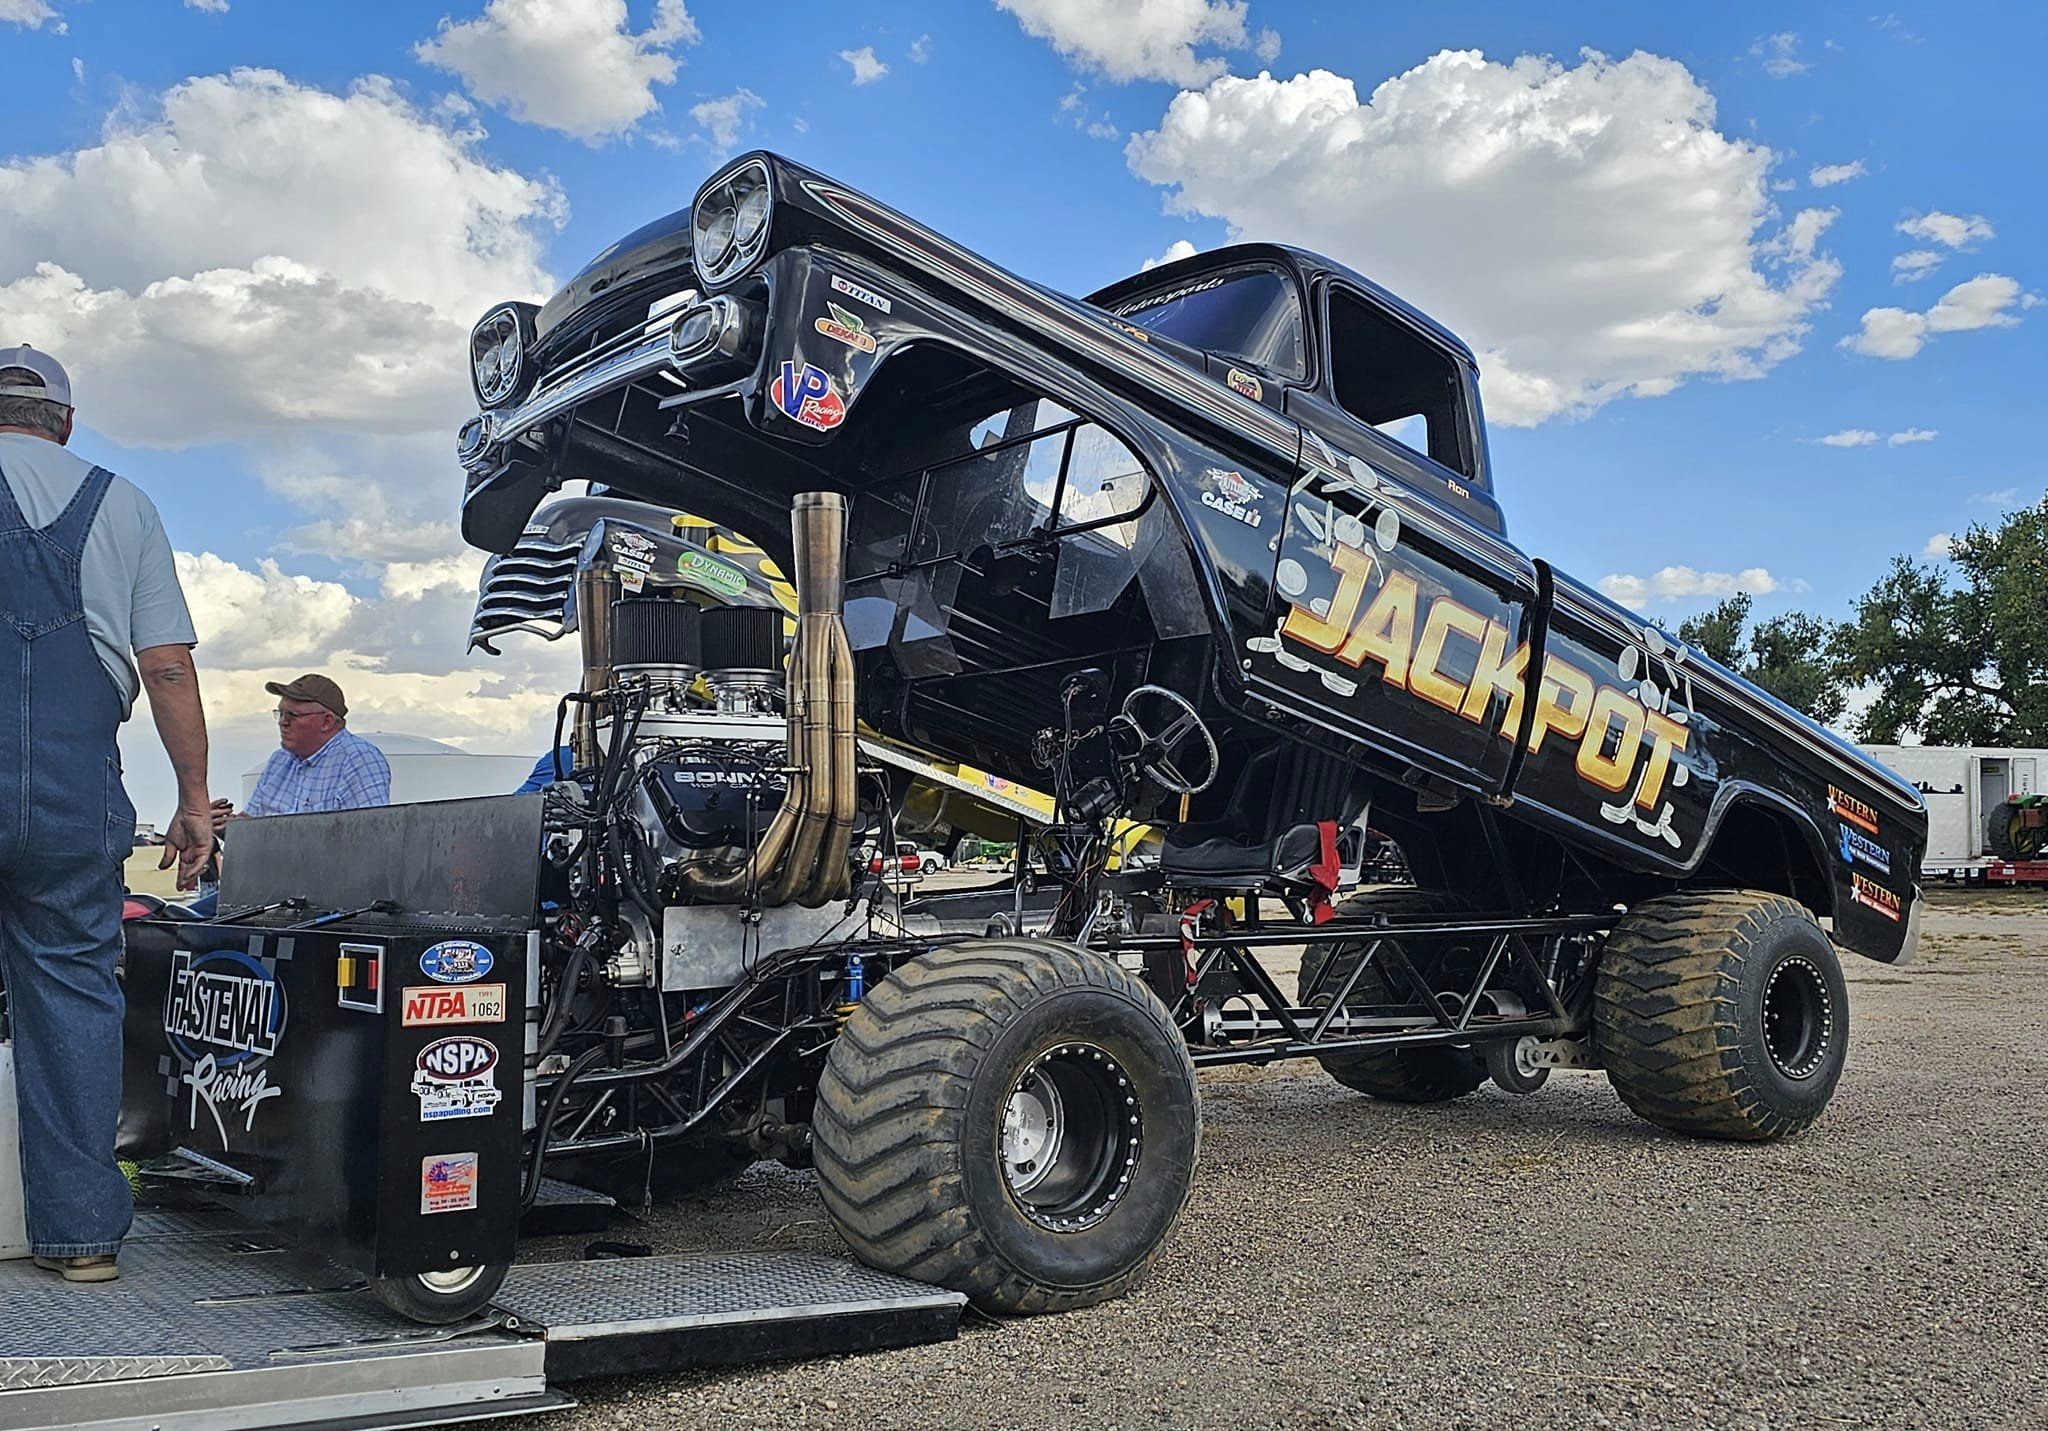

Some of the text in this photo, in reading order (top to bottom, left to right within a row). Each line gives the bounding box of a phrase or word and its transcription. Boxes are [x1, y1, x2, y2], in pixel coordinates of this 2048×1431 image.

[848, 285, 885, 308] TITAN
[781, 361, 830, 421] VP
[802, 400, 845, 422] Racing
[1448, 479, 1469, 499] Ron
[1201, 491, 1246, 521] CASE
[612, 544, 645, 560] CASE
[691, 554, 744, 587] DYNAMIC
[1281, 541, 1693, 811] JACKPOT
[1828, 784, 1878, 823] WESTERN
[1839, 822, 1890, 865] WESTERN
[1852, 871, 1901, 911] WESTERN
[165, 950, 277, 1057] FASTENAL
[406, 992, 466, 1020] NTPA
[471, 1002, 500, 1017] 1062
[426, 1043, 490, 1075] NSPA
[183, 1052, 282, 1153] Racing
[423, 1106, 491, 1119] nspapulling.com
